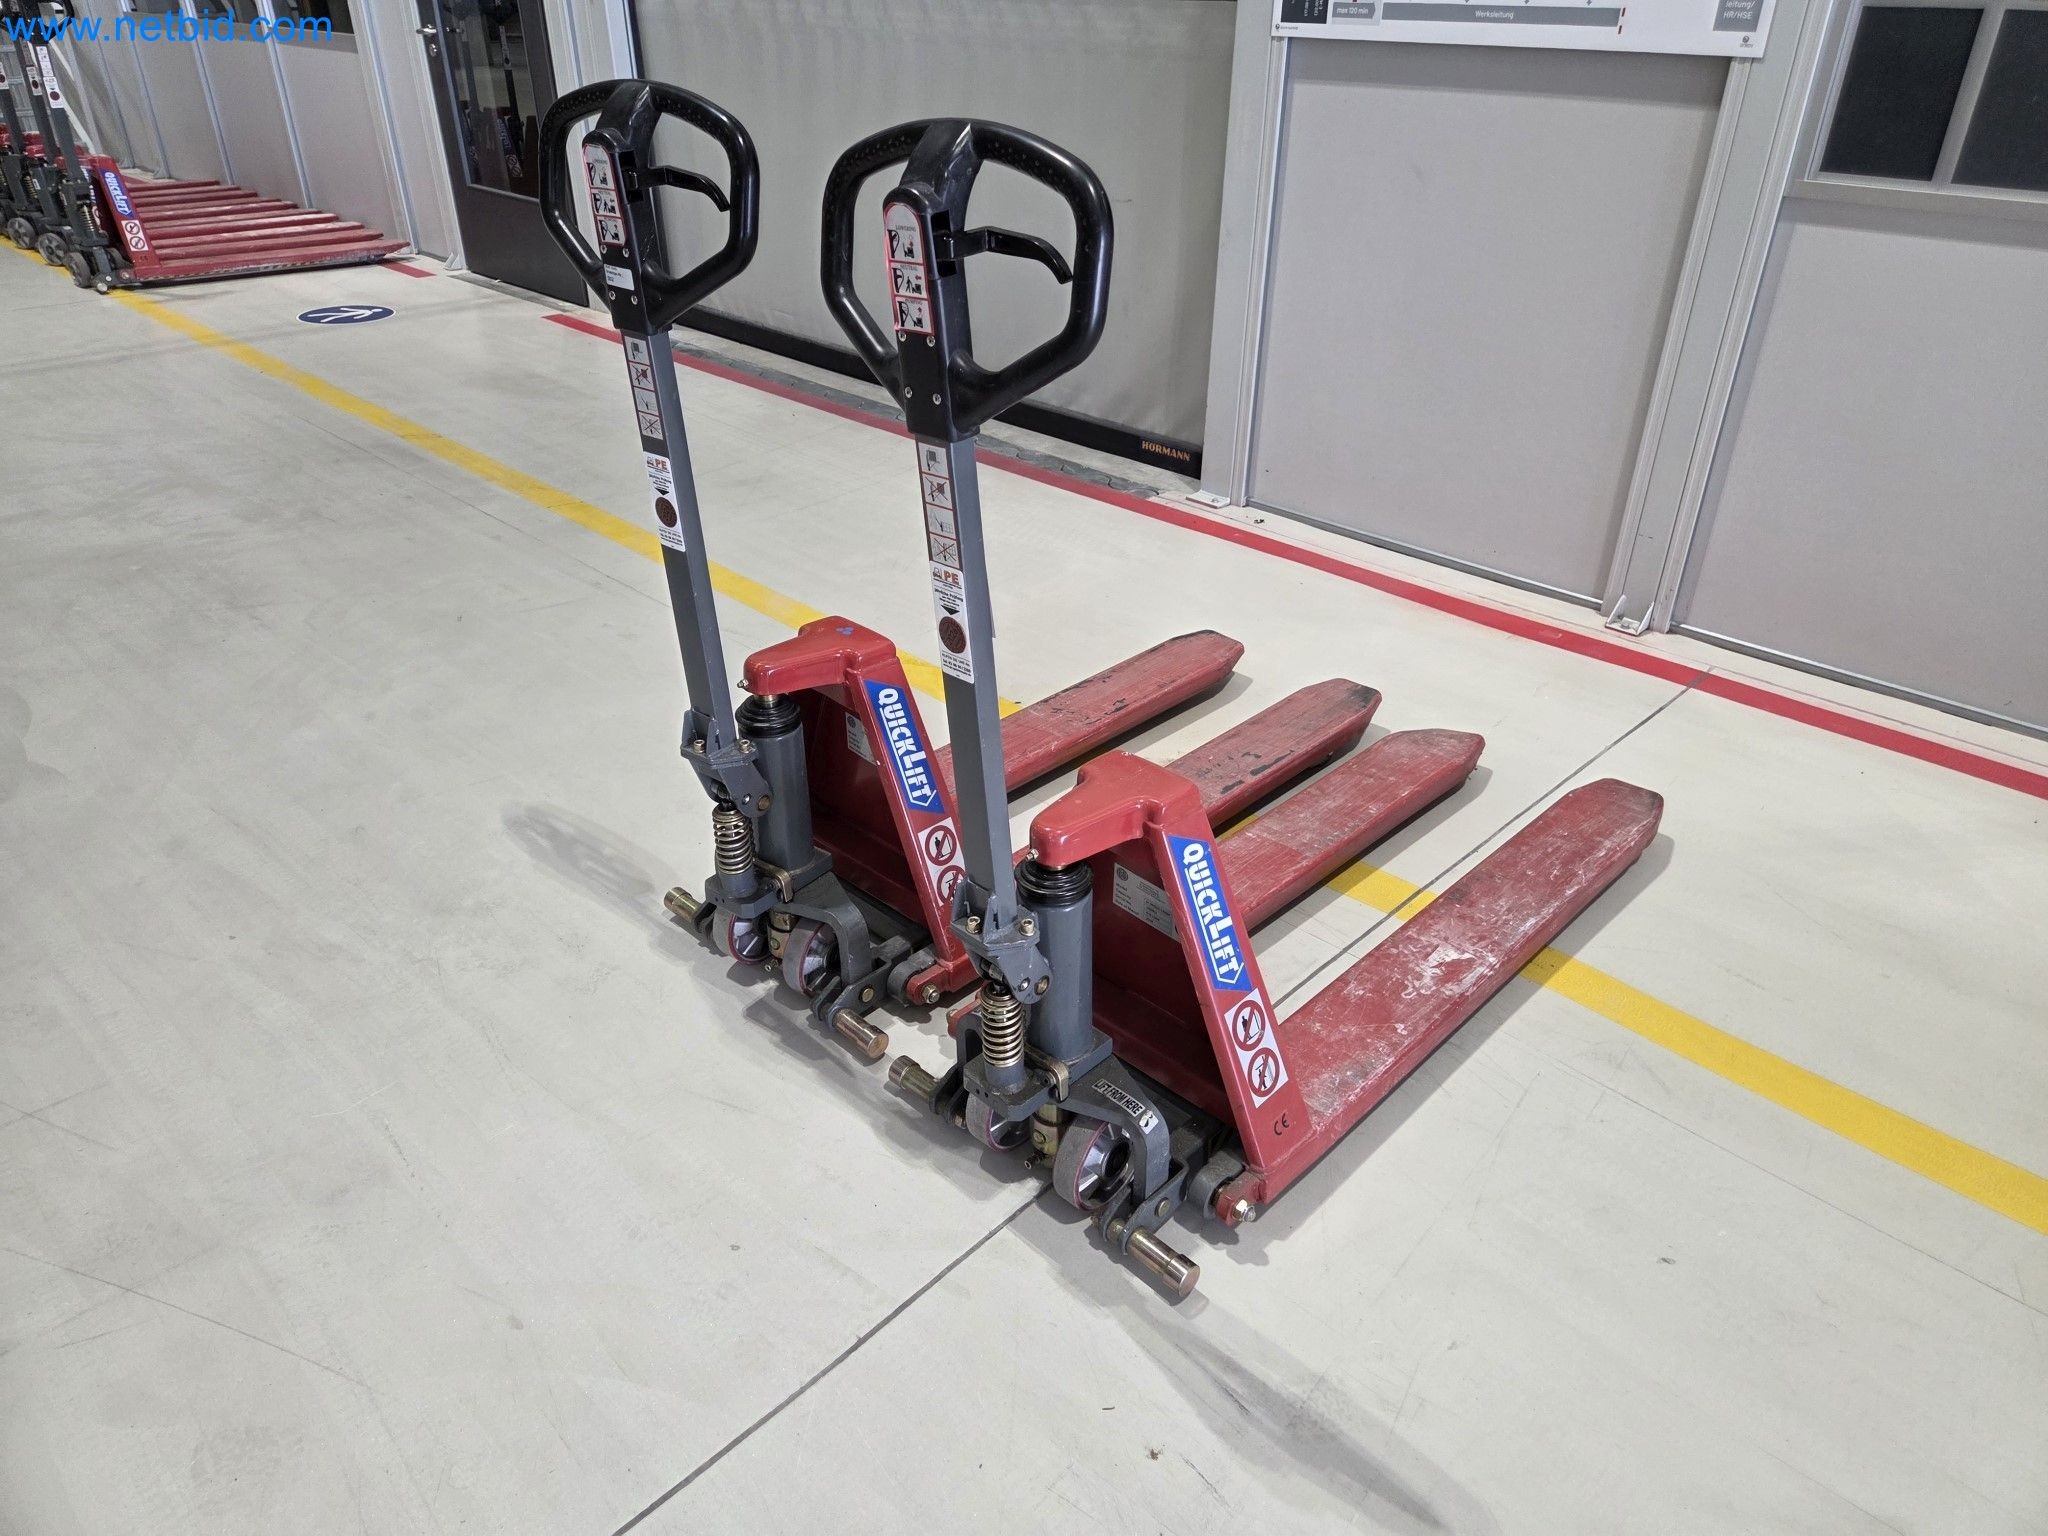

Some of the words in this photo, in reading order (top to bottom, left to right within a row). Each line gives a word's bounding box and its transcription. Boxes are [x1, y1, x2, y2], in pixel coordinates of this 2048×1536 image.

[1723, 11, 1753, 20] HR/HSE
[1094, 1080, 1112, 1095] LIFT
[1106, 1087, 1128, 1104] FROM
[1121, 1097, 1143, 1115] HERE
